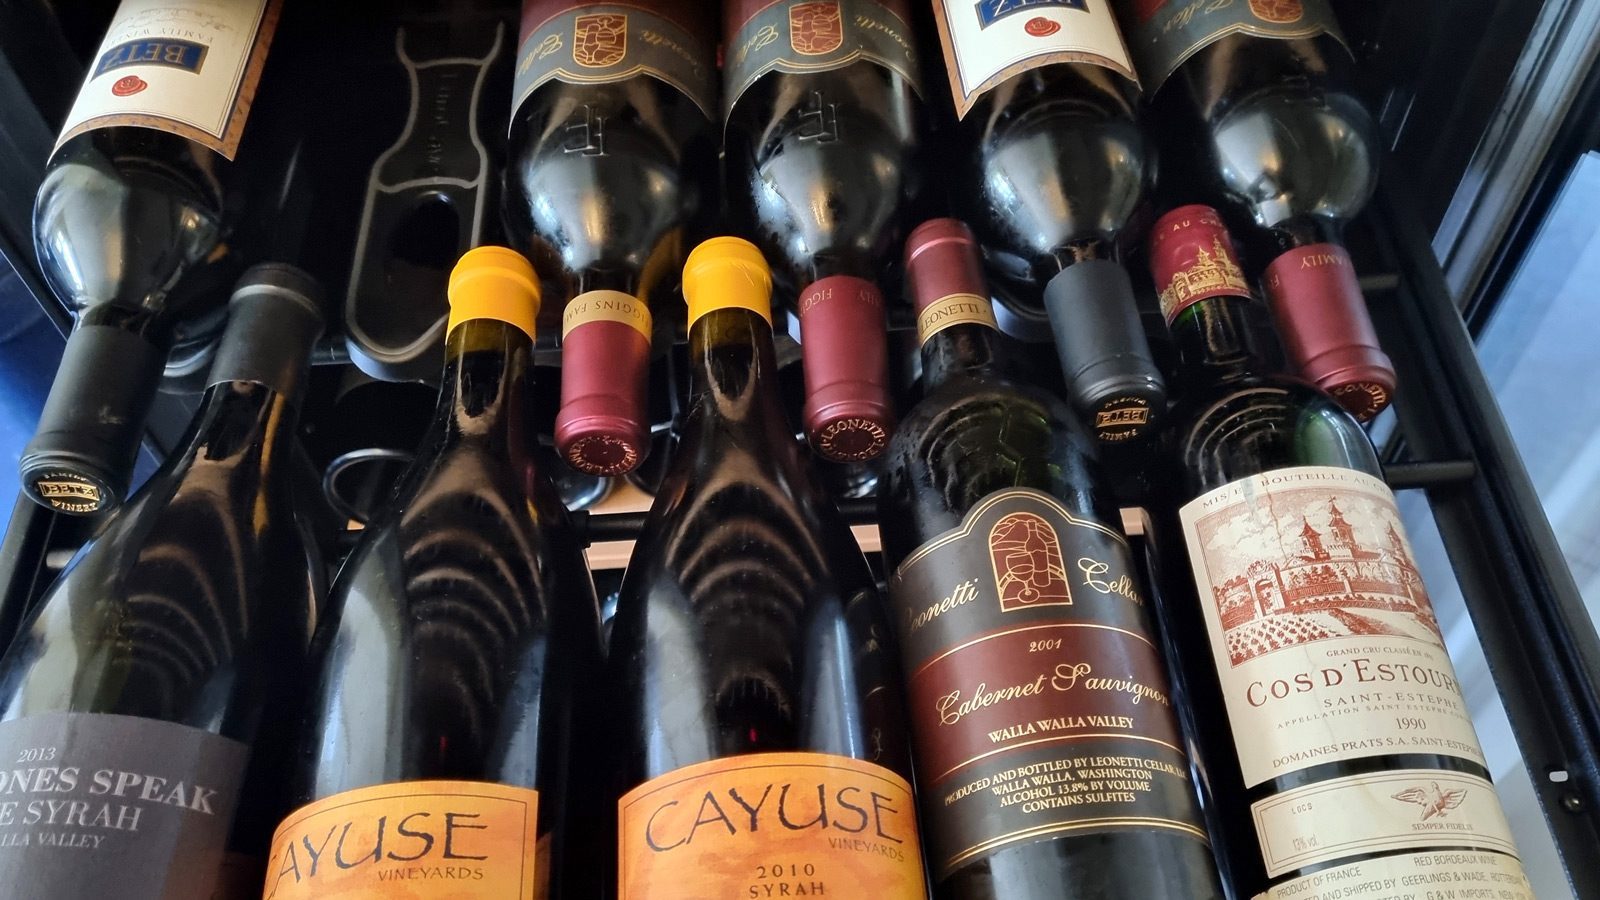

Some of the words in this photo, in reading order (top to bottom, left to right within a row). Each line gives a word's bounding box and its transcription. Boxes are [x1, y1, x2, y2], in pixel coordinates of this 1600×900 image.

[103, 42, 190, 71] BETZ
[920, 303, 980, 335] LEONETTI
[1261, 473, 1348, 487] BOUTEILLE
[1028, 638, 1063, 653] 2001
[1326, 646, 1361, 658] GRAND
[1362, 646, 1382, 654] CRU
[935, 674, 1048, 727] Cabernet
[1051, 662, 1169, 706] Sauvignon
[1246, 672, 1314, 708] COS
[987, 723, 1037, 744] WALLA
[1036, 717, 1087, 732] WALLA
[1086, 715, 1134, 730] VALLEY
[1276, 707, 1360, 730] APPELLATION
[1395, 717, 1427, 730] 1990
[16, 746, 57, 763] 2013
[1272, 743, 1339, 769] DOMAINES
[1341, 737, 1384, 752] PRATS
[1385, 736, 1409, 747] S.A.
[88, 768, 218, 816] SPEAK
[944, 777, 991, 807] PRODUCED
[992, 771, 1017, 786] AND
[1017, 759, 1072, 780] BOTTLED
[1074, 757, 1088, 768] BY
[1090, 756, 1143, 769] LEONETTI
[991, 780, 1030, 796] WALLA
[1031, 772, 1075, 787] WALLA,
[1077, 769, 1153, 781] WASHINGTON
[999, 790, 1052, 808] ALCOHOL
[1057, 783, 1089, 795] 13.8%
[1090, 781, 1105, 792] BY
[1105, 780, 1152, 793] VOLUME
[22, 800, 144, 832] SYRAH
[1021, 794, 1084, 815] CONTAINS
[1084, 792, 1136, 804] SULFITES
[645, 783, 904, 853] CAYUSE
[1411, 822, 1444, 831] SEMPER
[38, 831, 106, 849] VALLEY
[828, 836, 905, 863] VINEYARDS
[267, 812, 489, 899] AYUSE
[1413, 856, 1433, 867] RED
[1433, 854, 1477, 866] BORDEAUX
[1479, 855, 1498, 866] WINE
[377, 866, 485, 882] VINEYARDS
[756, 862, 816, 879] 2010
[1276, 879, 1312, 900] PRODUCT
[1313, 875, 1324, 887] OF
[1325, 866, 1363, 884] FRANCE
[749, 881, 826, 900] SYRAH
[1343, 880, 1383, 897] SHIPPED
[1383, 877, 1397, 889] BY
[1401, 871, 1453, 887] GEERLINGS
[1452, 871, 1461, 881] &
[1461, 871, 1489, 882] WADE
[1444, 889, 1456, 900] W
